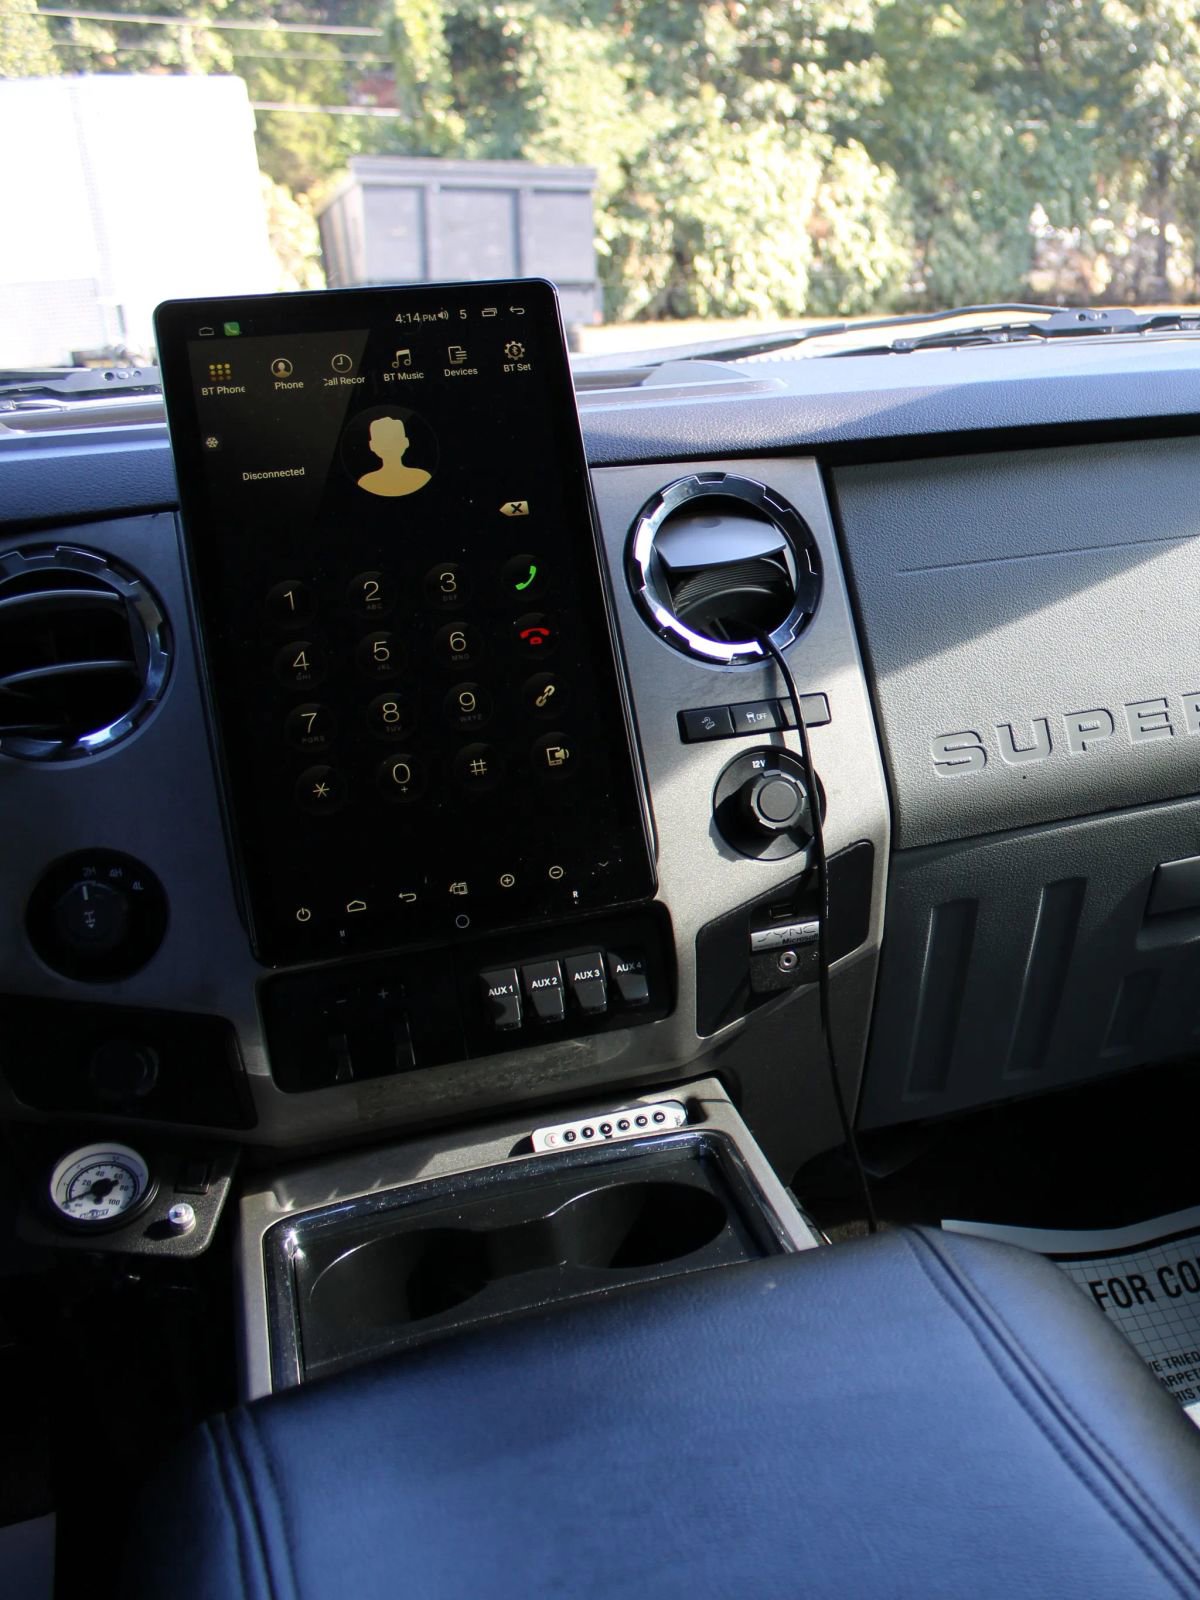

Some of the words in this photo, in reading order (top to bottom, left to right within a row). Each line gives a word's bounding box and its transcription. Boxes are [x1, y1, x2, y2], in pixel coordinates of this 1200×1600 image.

[395, 312, 420, 325] 4:14
[423, 313, 437, 323] PM
[460, 309, 468, 320] 5
[444, 367, 479, 378] Devices
[502, 364, 515, 374] BT
[516, 362, 532, 373] Set
[339, 376, 366, 385] Recor
[384, 372, 397, 382] BT
[398, 371, 425, 381] Music
[202, 387, 215, 397] BT
[274, 380, 305, 391] Phone
[242, 466, 306, 482] Disconnected
[439, 572, 457, 592] 3
[363, 580, 382, 602] 2
[282, 590, 296, 611] 1
[449, 631, 467, 652] 6
[373, 641, 391, 662] 5
[292, 651, 310, 671] 4
[459, 692, 477, 713] 9
[382, 702, 400, 722] 8
[756, 712, 768, 721] OFF
[300, 712, 318, 734] 7
[470, 758, 488, 776] #
[752, 759, 766, 769] 12V
[392, 763, 411, 784] 0
[616, 963, 635, 973] AUX
[574, 971, 593, 981] AUX
[594, 969, 601, 978] 3
[531, 978, 551, 989] AUX
[551, 977, 558, 986] 2
[488, 986, 508, 997] AUX
[508, 985, 514, 993] 1
[82, 1179, 92, 1187] 20
[1088, 1273, 1155, 1311] FOR
[1171, 1387, 1196, 1402] HIS
